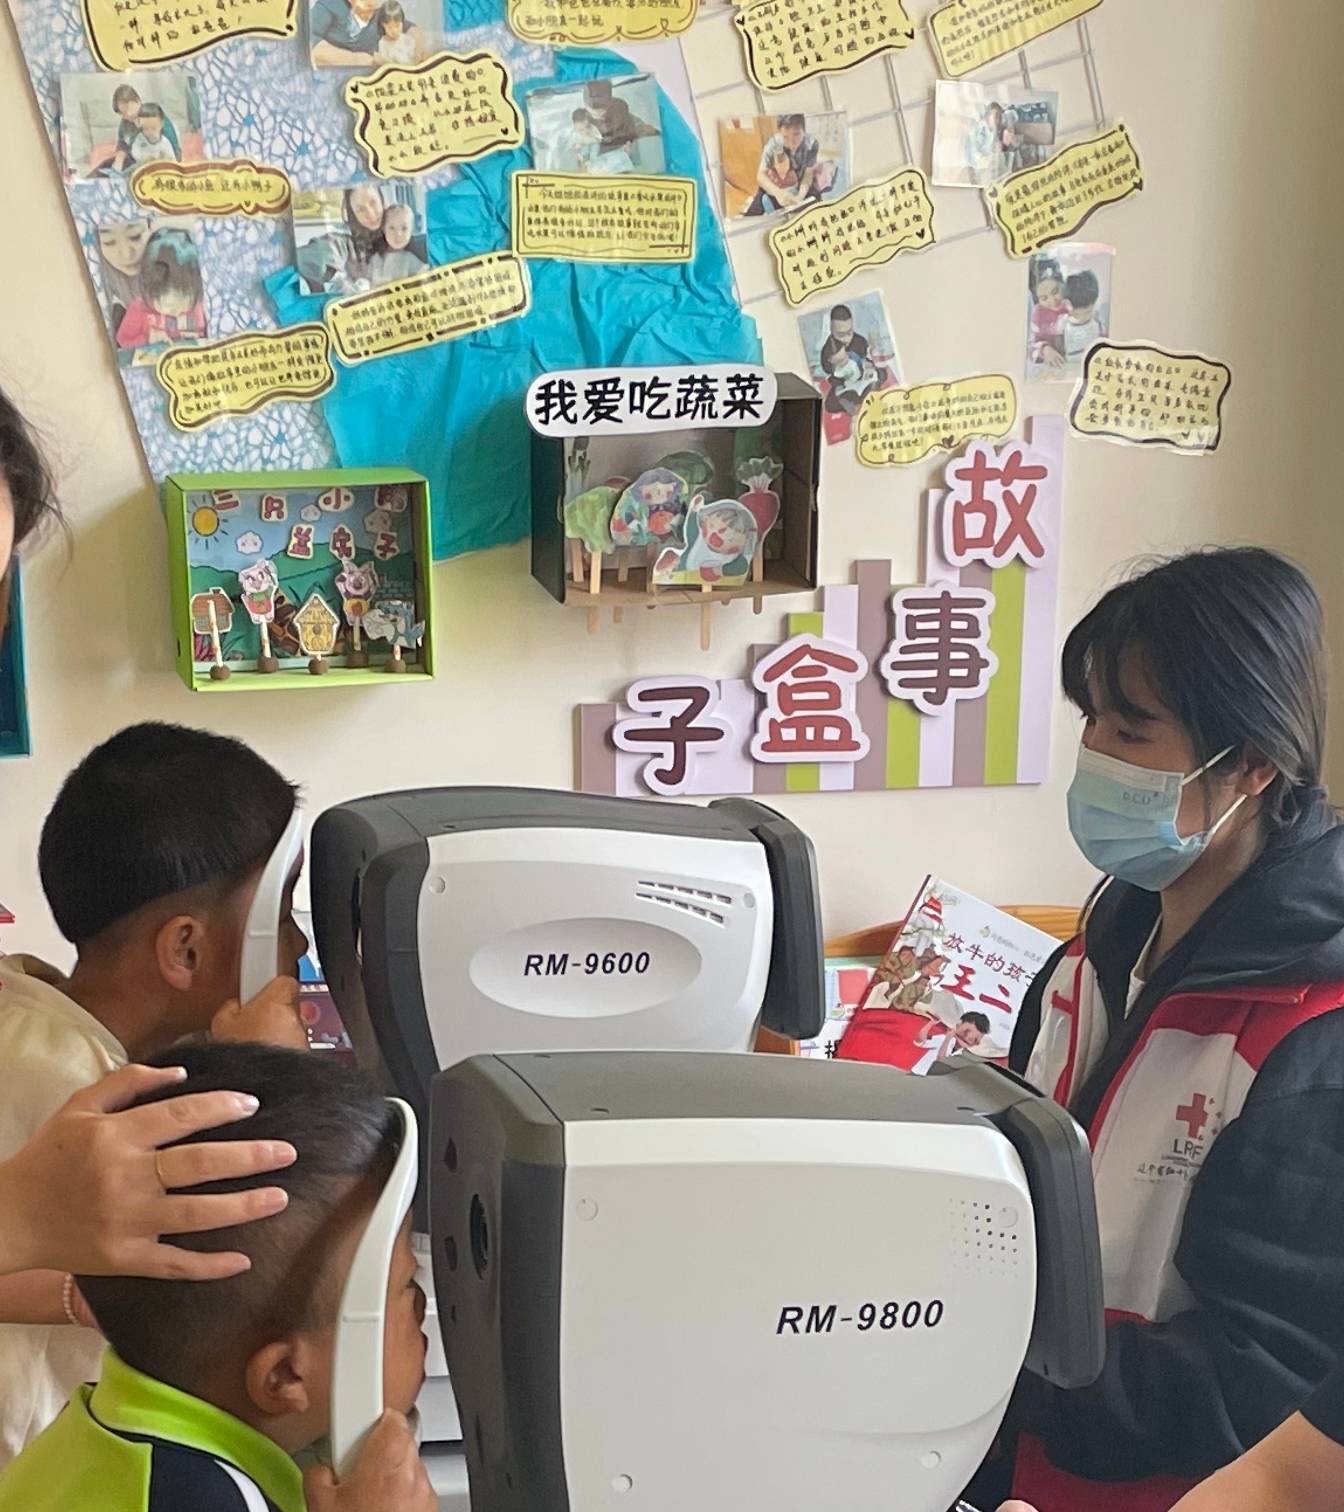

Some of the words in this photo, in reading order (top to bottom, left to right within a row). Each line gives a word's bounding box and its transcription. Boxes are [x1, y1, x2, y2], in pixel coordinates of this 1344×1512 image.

[534, 372, 765, 426] 我爱吃蔬菜
[523, 951, 651, 978] RM-9600
[775, 1300, 946, 1336] RM-9800
